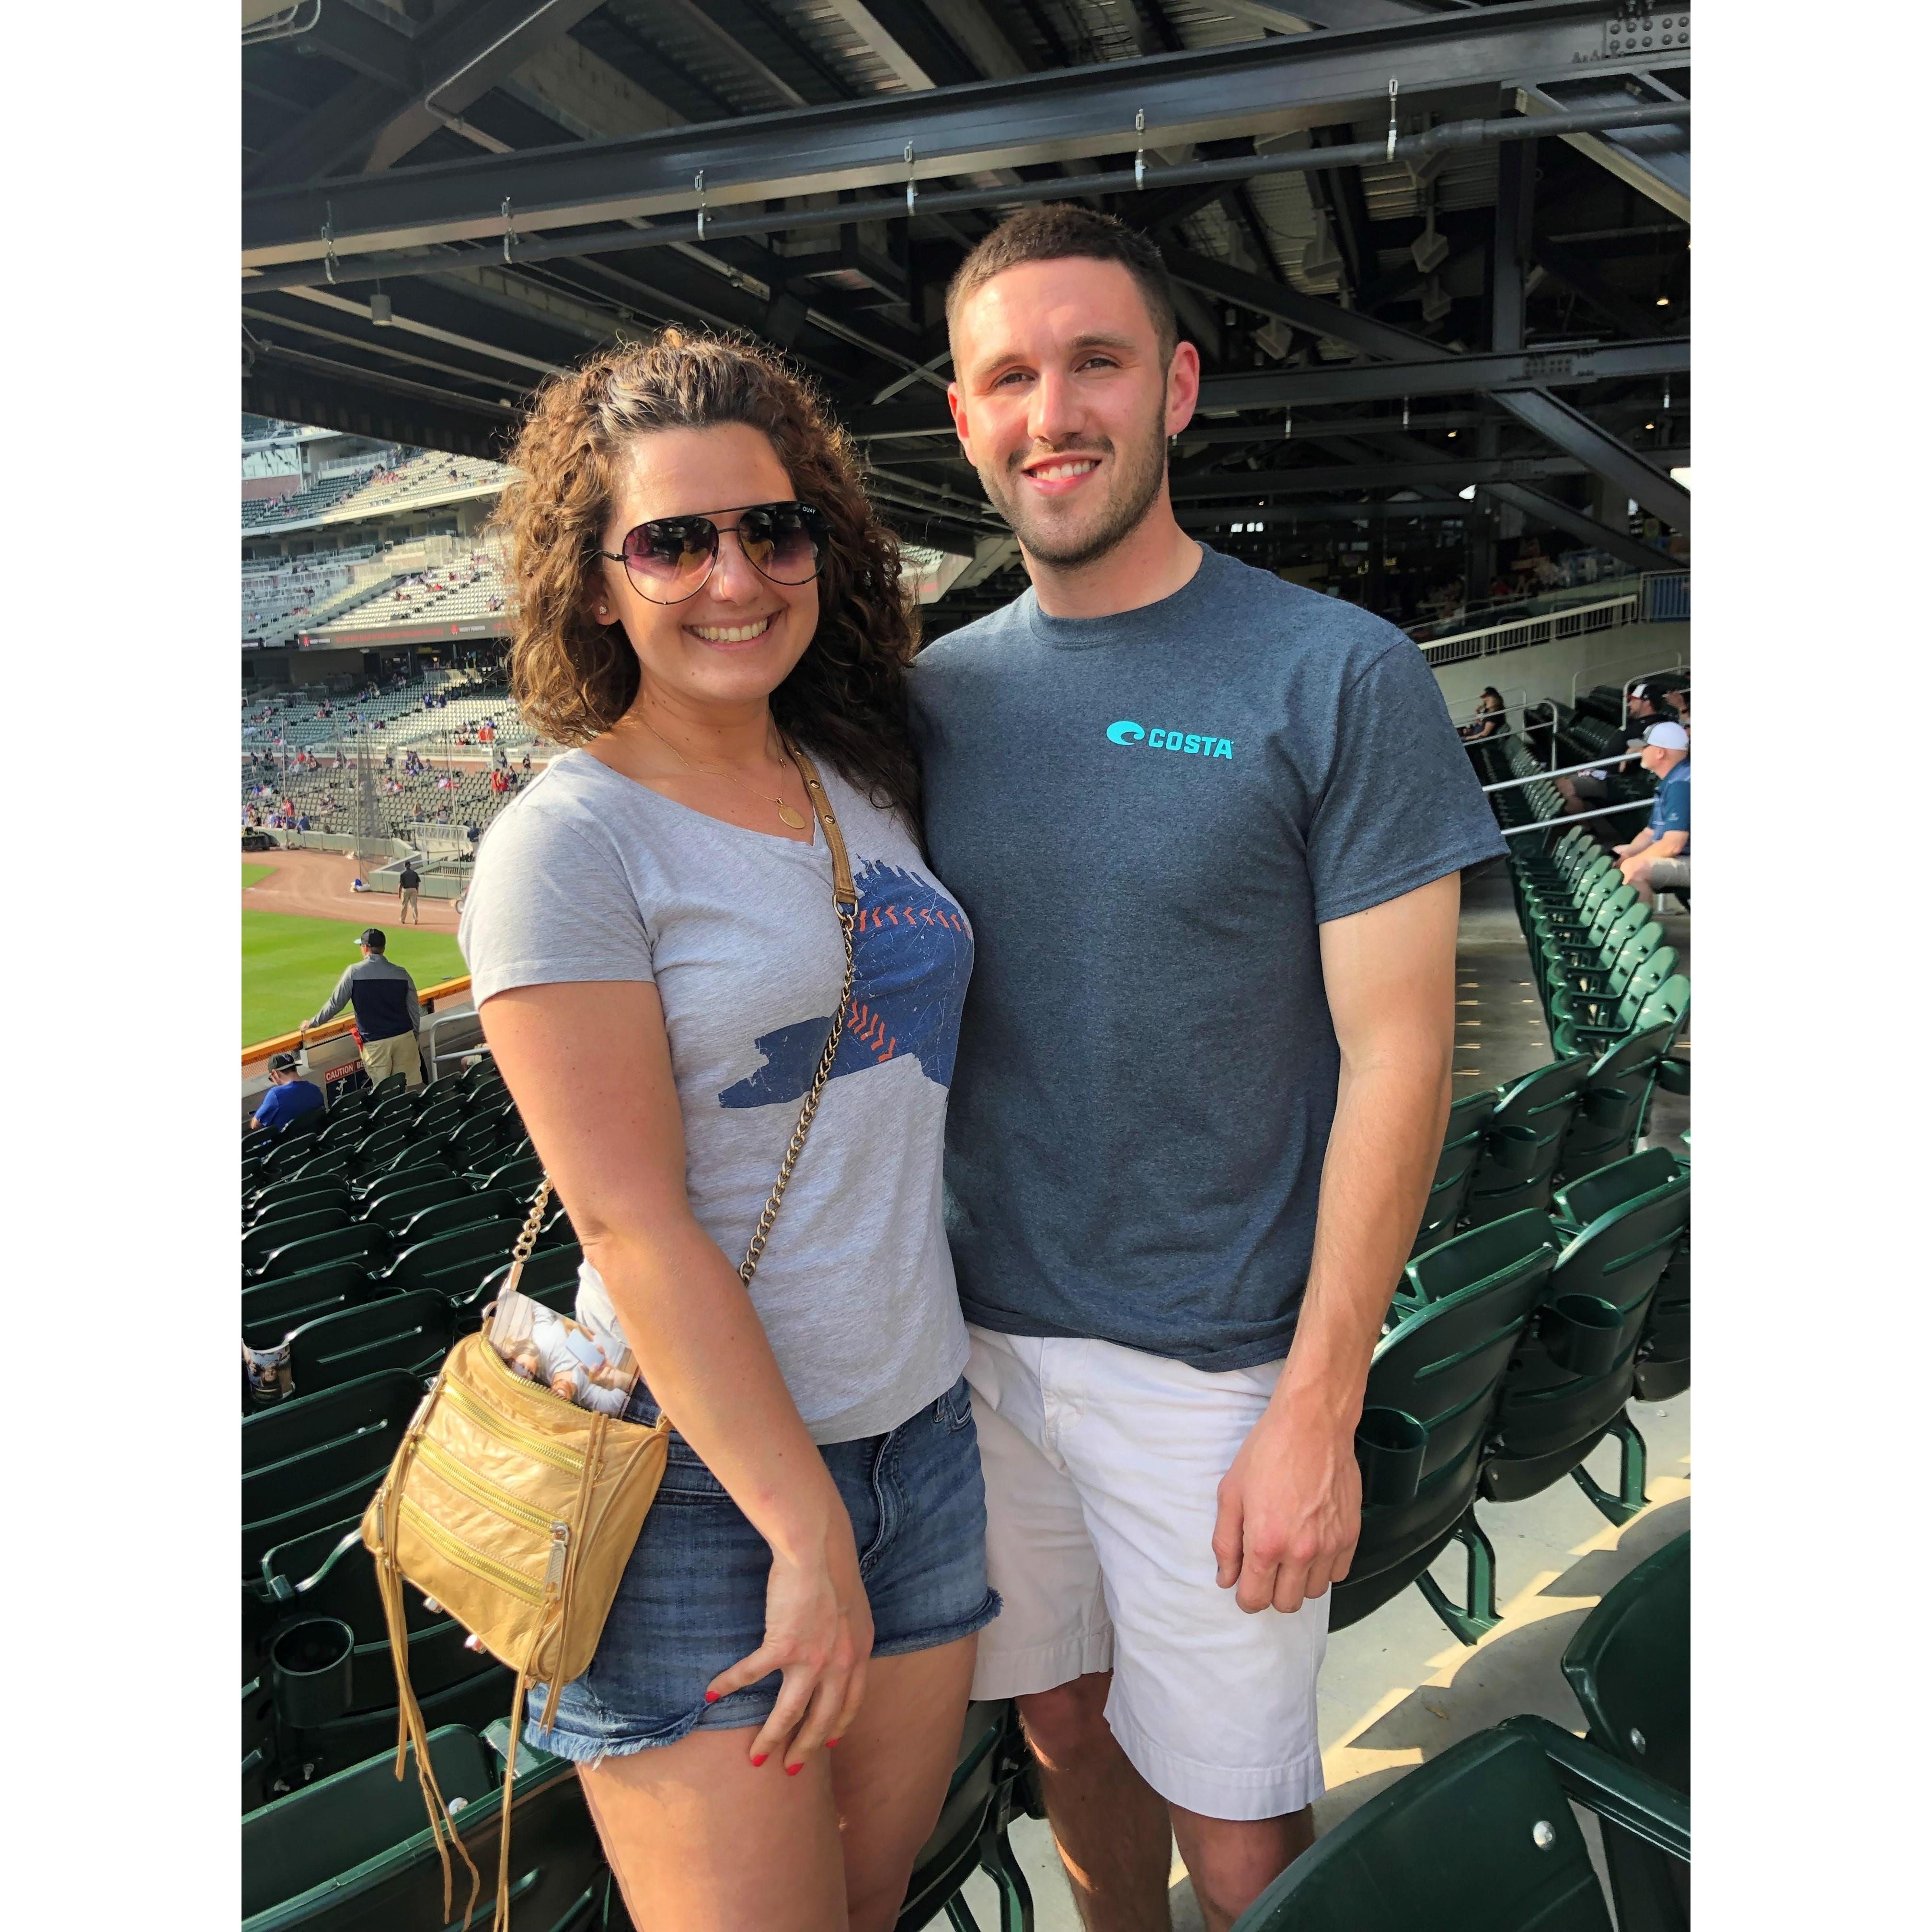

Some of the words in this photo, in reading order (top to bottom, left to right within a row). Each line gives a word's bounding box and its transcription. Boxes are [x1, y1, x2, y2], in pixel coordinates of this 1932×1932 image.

[802, 506, 816, 514] QUAY
[1148, 728, 1232, 759] COSTA
[326, 1063, 354, 1081] CAUTION
